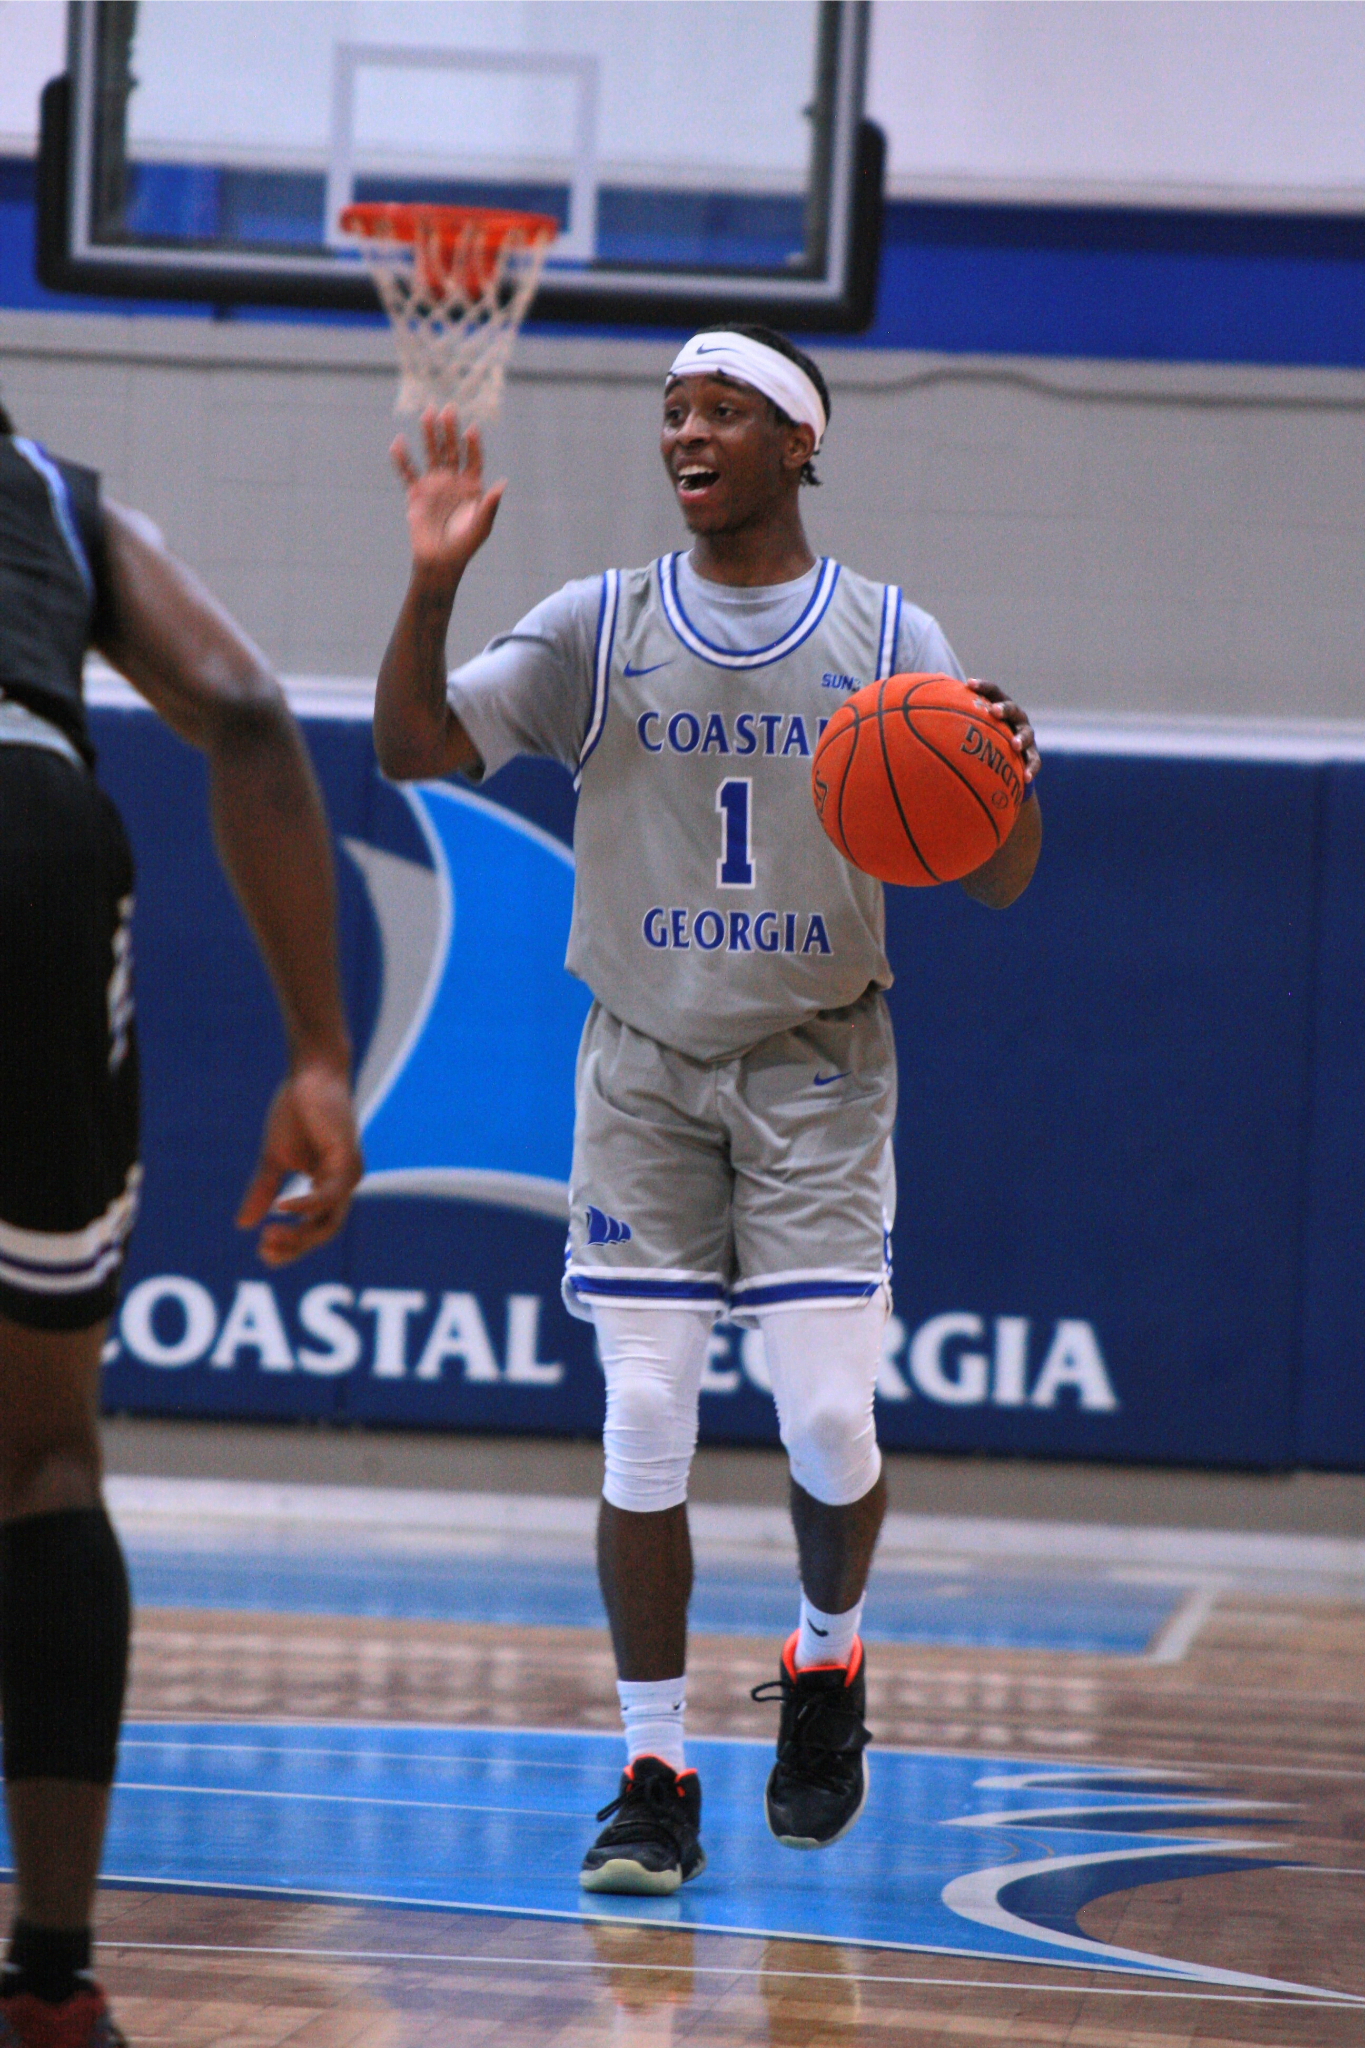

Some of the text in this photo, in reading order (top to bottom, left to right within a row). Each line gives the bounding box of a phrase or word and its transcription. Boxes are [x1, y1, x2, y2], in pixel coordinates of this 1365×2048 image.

[637, 710, 829, 758] COASTA
[715, 777, 755, 889] 1
[642, 906, 834, 955] GEORGIA
[101, 1274, 564, 1385] OASTAL
